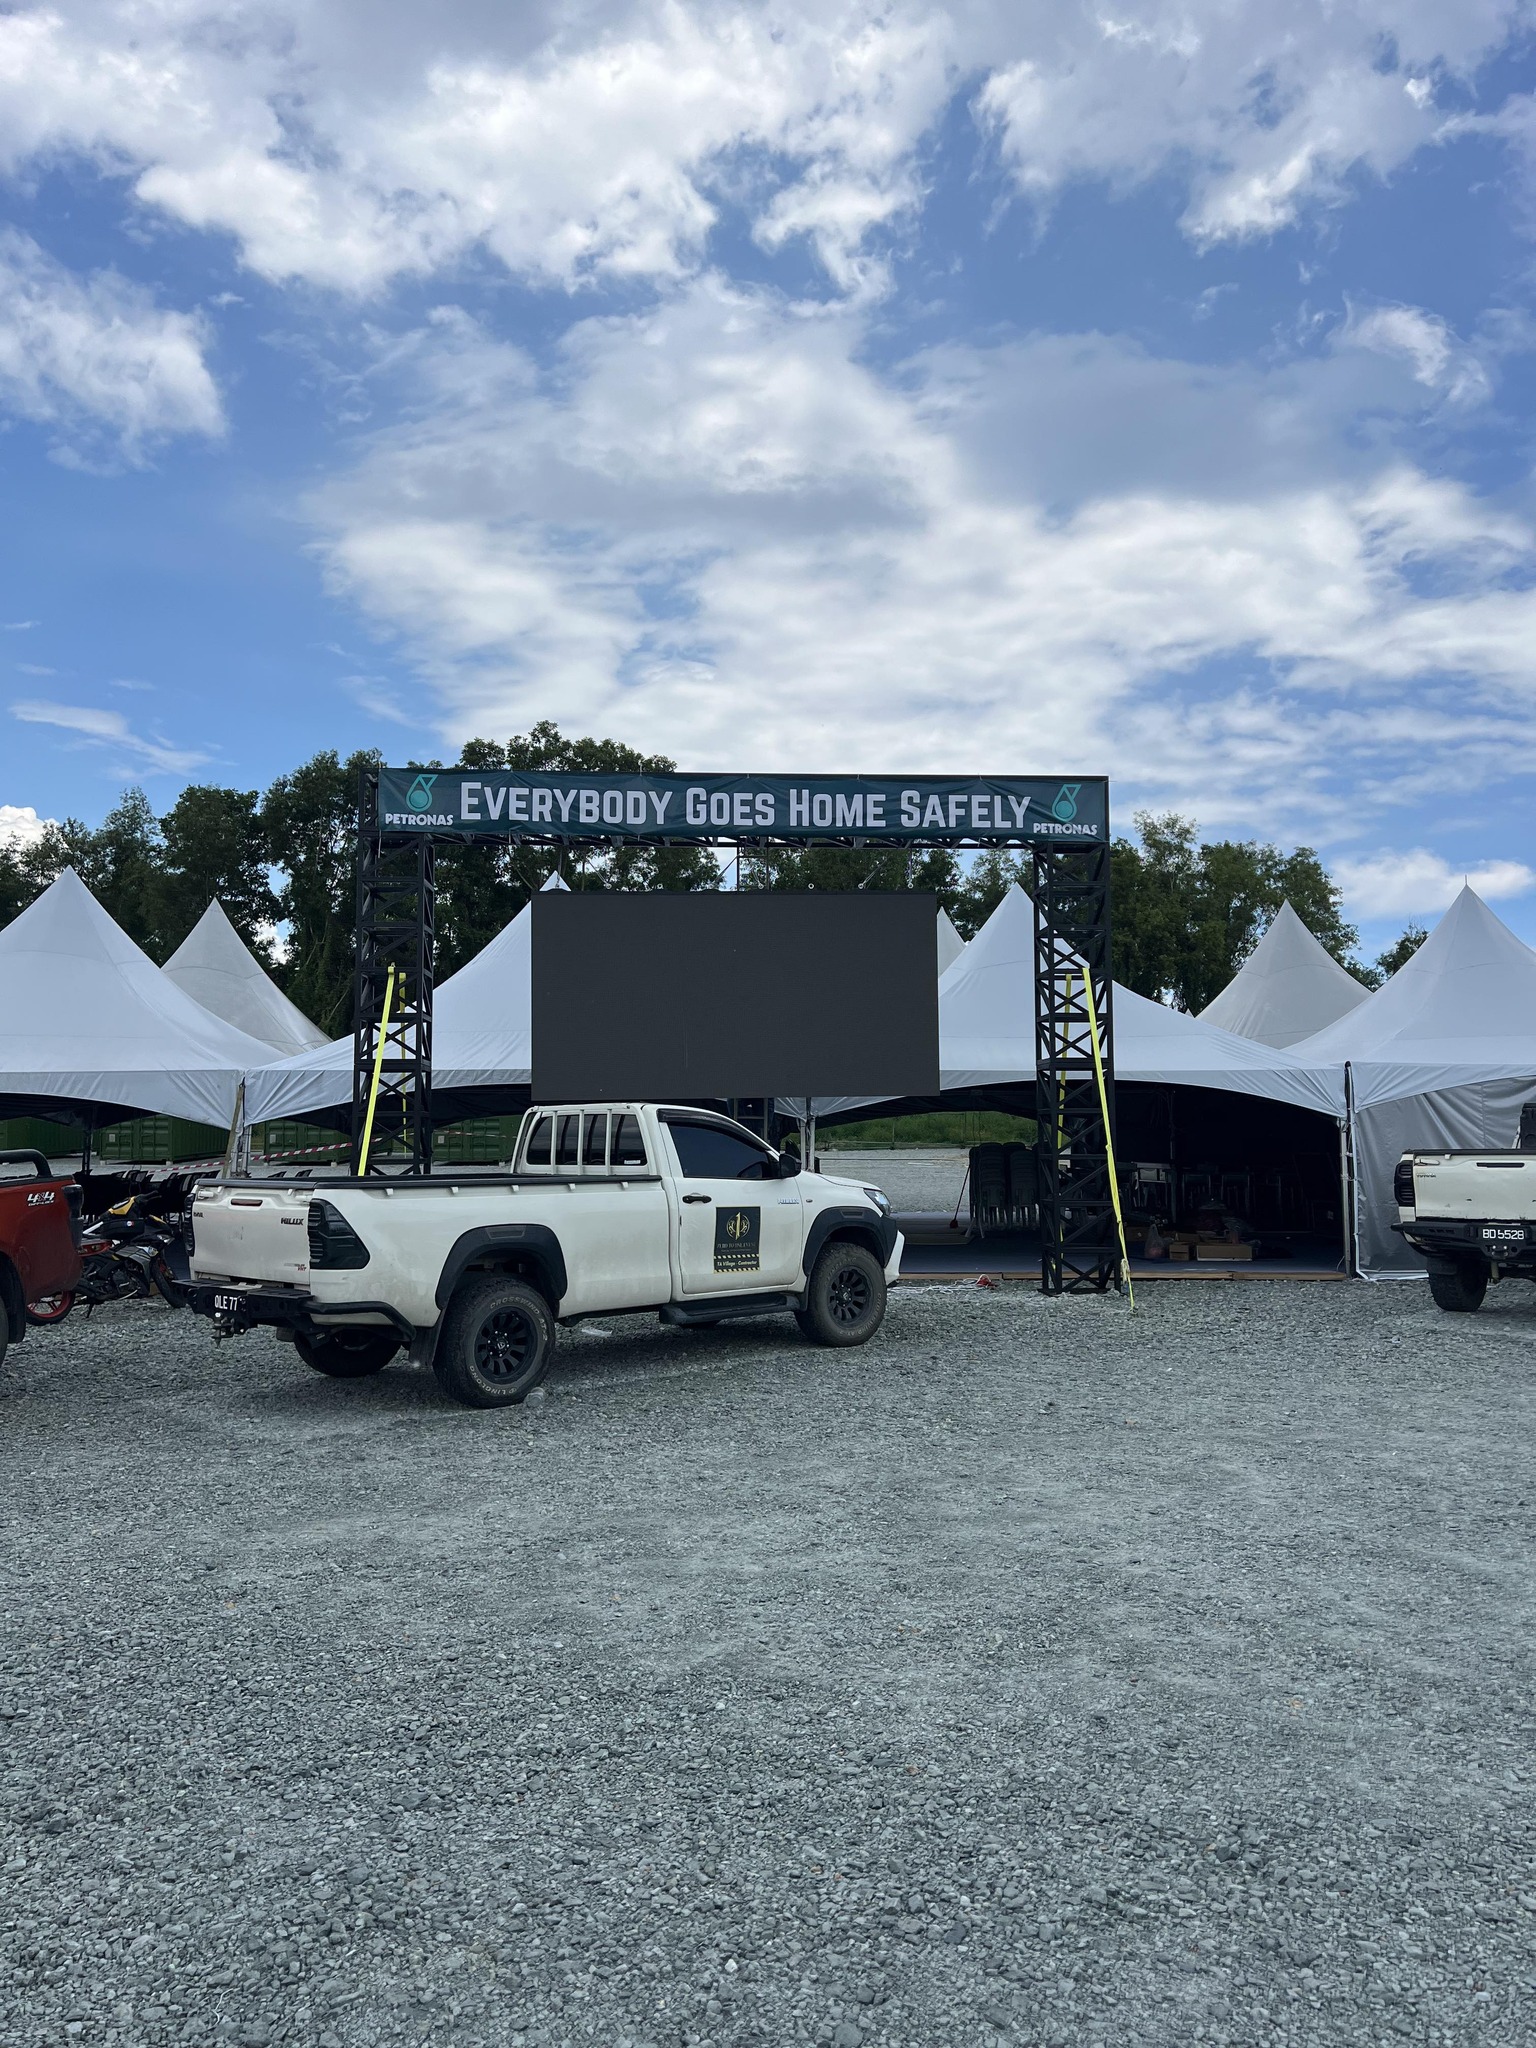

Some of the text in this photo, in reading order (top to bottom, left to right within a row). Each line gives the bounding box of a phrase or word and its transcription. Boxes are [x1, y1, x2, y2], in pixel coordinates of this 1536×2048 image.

[460, 781, 1032, 829] EVERYBODY GOES HOME SAFELY
[385, 813, 453, 826] PETRONAS
[1033, 822, 1097, 835] PETRONAS
[280, 1217, 304, 1226] HILUX
[1482, 1229, 1525, 1240] BD 5528
[490, 1296, 540, 1315] CROSSWIND
[469, 1365, 507, 1395] LINGLONG
